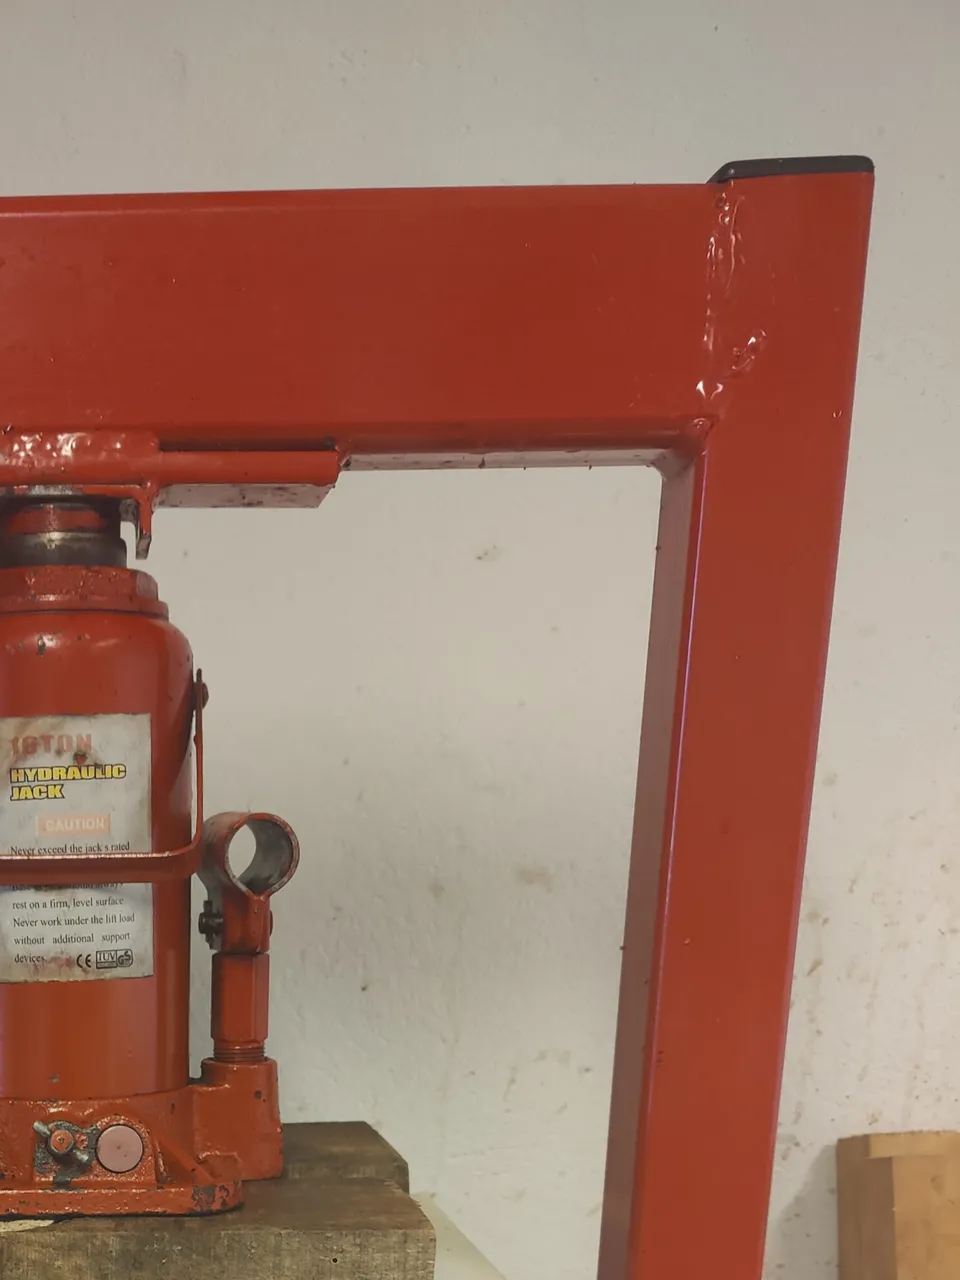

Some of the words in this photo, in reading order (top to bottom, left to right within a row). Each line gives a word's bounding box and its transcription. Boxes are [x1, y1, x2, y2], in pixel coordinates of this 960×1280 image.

[10, 764, 127, 783] HYDRAULIC
[10, 784, 65, 801] JACK
[45, 817, 105, 832] CAUTION
[10, 846, 36, 856] Never
[37, 844, 67, 855] exceed
[69, 843, 83, 854] the
[111, 841, 131, 852] rated
[12, 901, 27, 910] rest
[29, 901, 40, 909] on
[50, 898, 71, 909] firm,
[73, 897, 93, 908] level
[95, 896, 125, 907] surface
[13, 918, 38, 928] Never
[40, 917, 62, 927] work
[64, 916, 88, 926] under
[90, 915, 104, 924] the
[105, 914, 117, 924] lift
[119, 913, 135, 923] load
[14, 935, 45, 945] without
[52, 933, 94, 945] additional
[101, 932, 131, 943] support
[76, 953, 92, 969] CE
